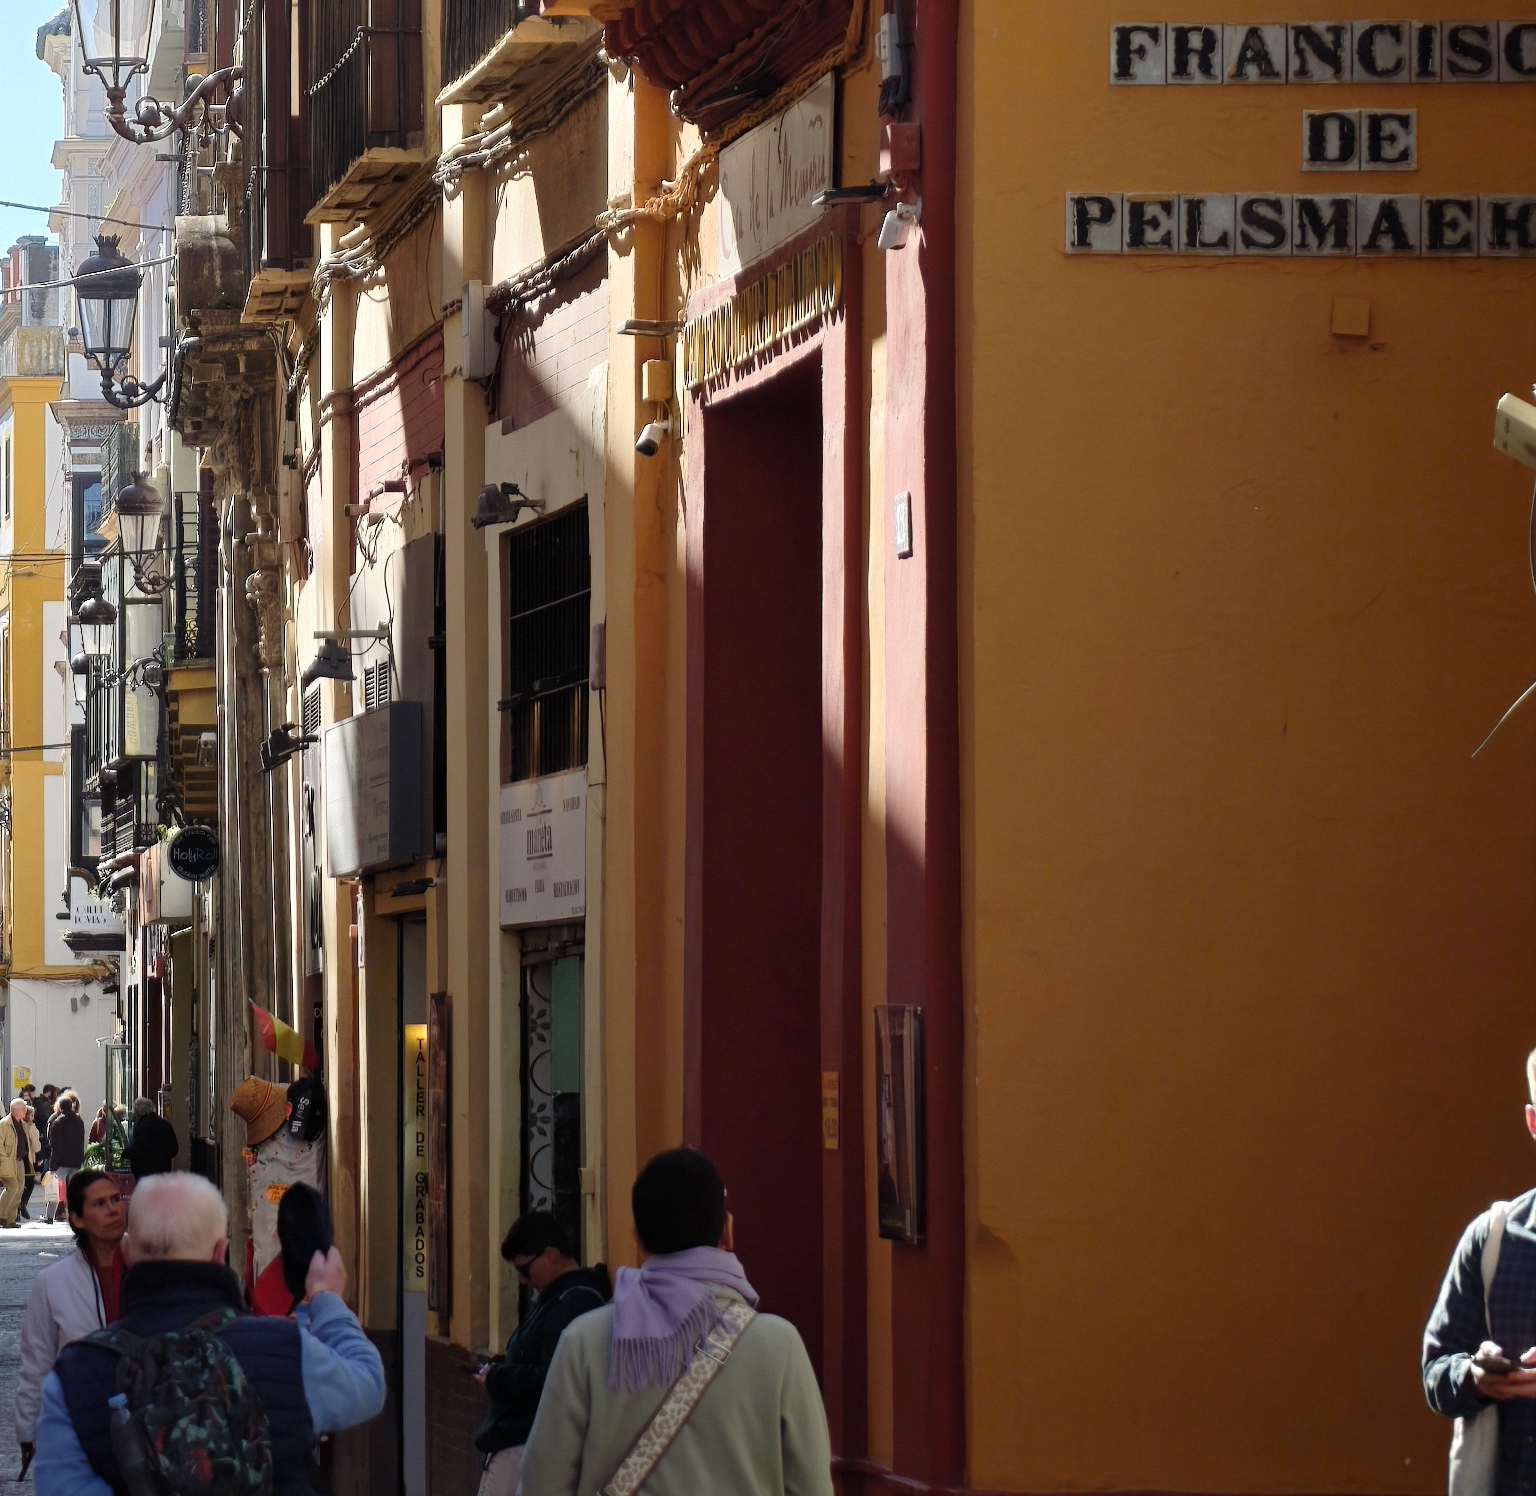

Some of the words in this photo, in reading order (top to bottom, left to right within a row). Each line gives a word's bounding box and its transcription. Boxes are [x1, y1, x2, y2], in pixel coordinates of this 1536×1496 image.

[1306, 111, 1412, 164] DE
[415, 1038, 426, 1117] TALLER
[416, 1132, 425, 1158] DE
[415, 1172, 426, 1278] GRABADOS
